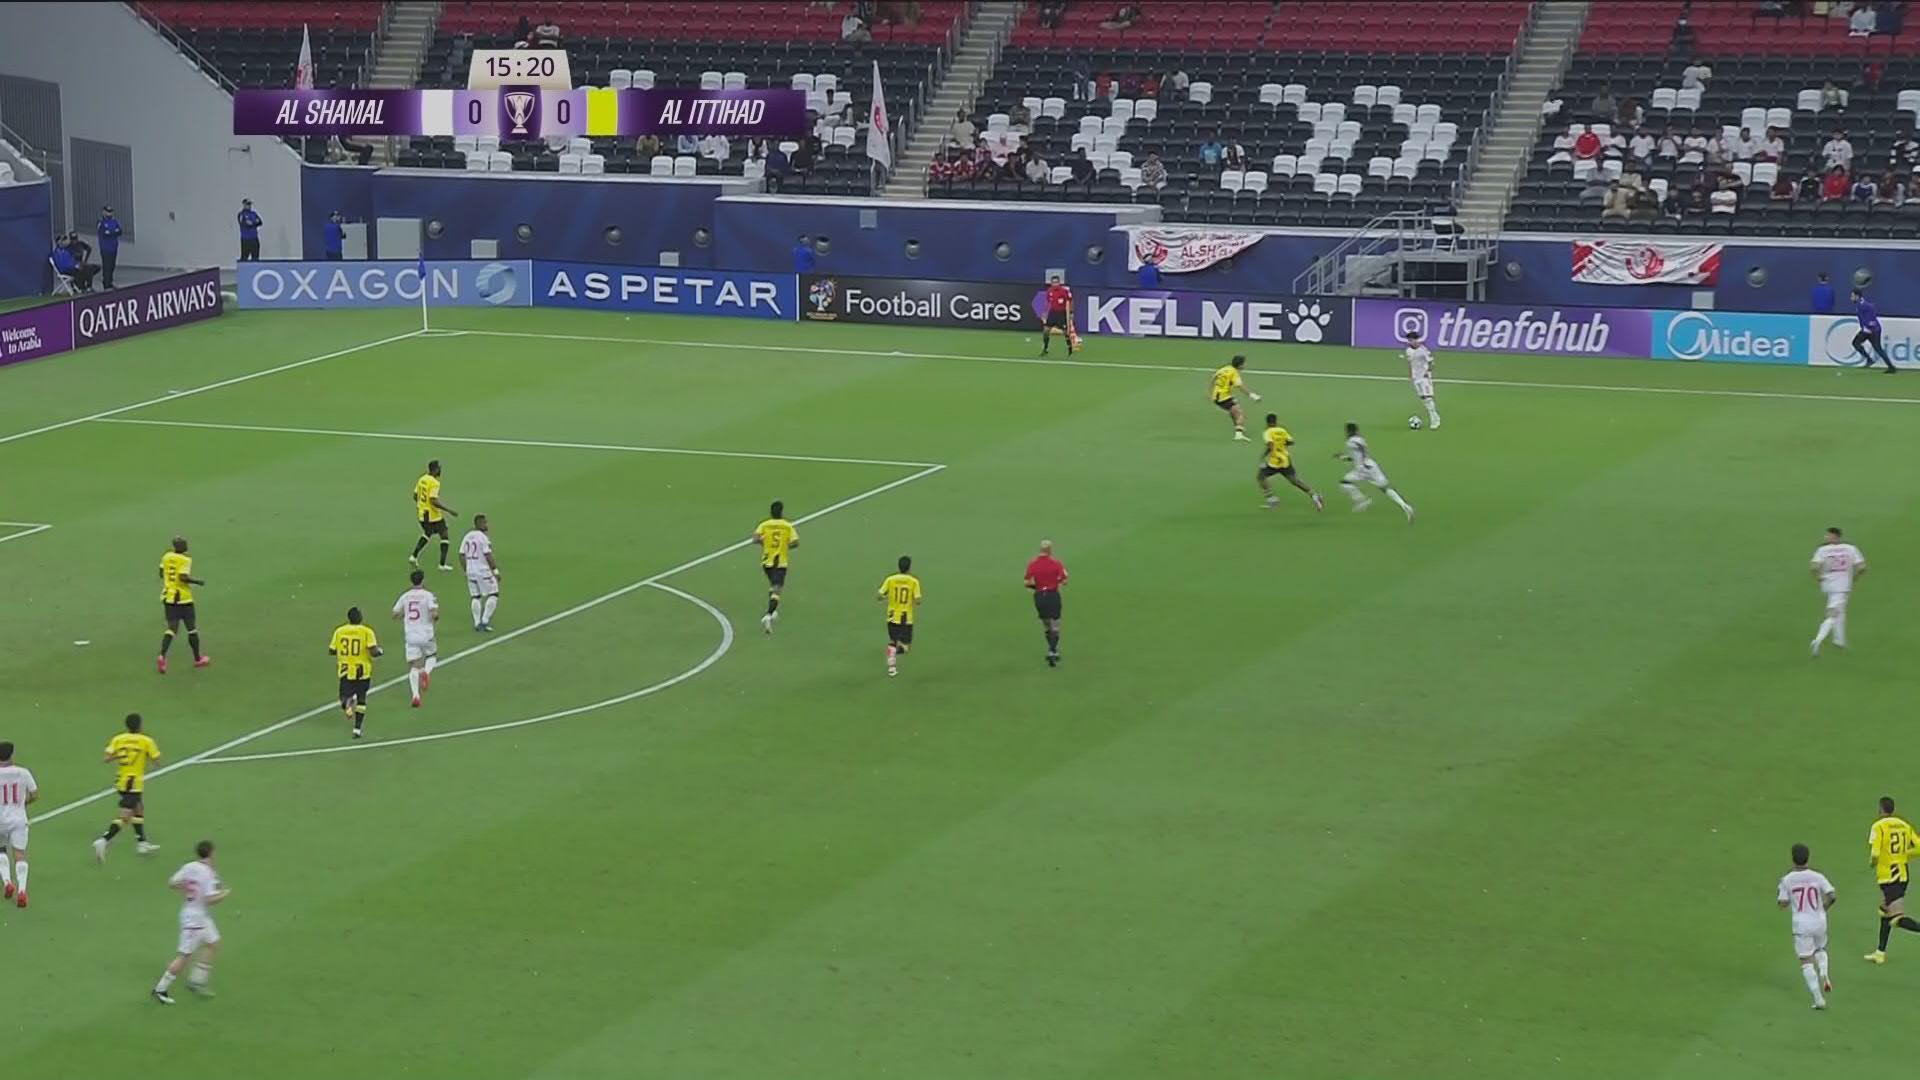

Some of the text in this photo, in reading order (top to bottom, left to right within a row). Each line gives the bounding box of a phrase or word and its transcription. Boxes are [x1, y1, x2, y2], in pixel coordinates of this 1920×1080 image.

[252, 268, 459, 301] OXAGON
[548, 271, 782, 316] ASPETAR
[79, 281, 217, 338] QATAR AIRWAYS
[845, 289, 1022, 322] Football Cares
[1087, 295, 1283, 340] KELME
[1, 327, 36, 343] Welcome
[1437, 307, 1610, 353] theafchub
[8, 342, 18, 354] to
[18, 338, 42, 353] Arabia
[1689, 328, 1790, 359] Midea
[893, 586, 909, 605] 10
[408, 600, 420, 621] 5
[340, 637, 361, 656] 30
[2, 782, 18, 805] 11
[1890, 831, 1906, 855] 21
[1791, 886, 1818, 912] 70
